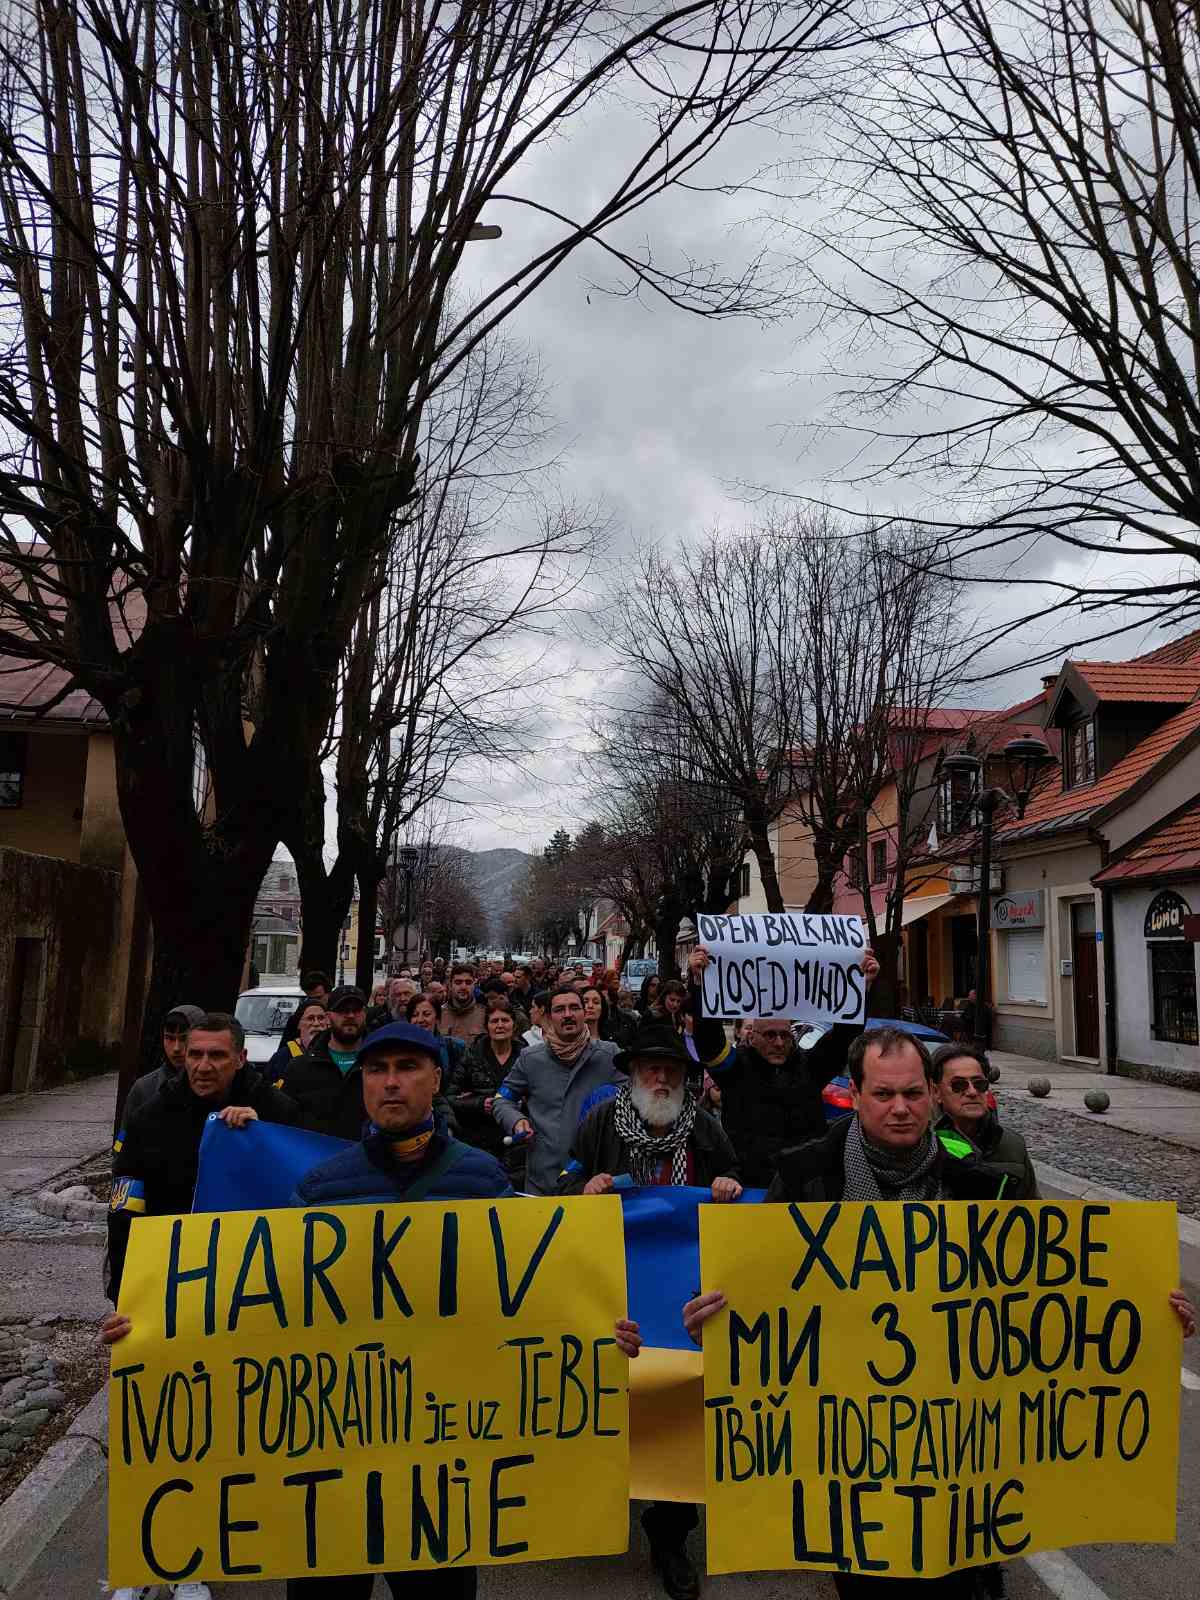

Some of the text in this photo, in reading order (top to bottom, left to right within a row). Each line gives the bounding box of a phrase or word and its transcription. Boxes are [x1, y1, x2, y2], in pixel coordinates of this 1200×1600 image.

[701, 914, 864, 949] OPEN BALKANS
[703, 955, 789, 1017] CLOSED
[165, 1206, 564, 1339] HARKIV
[788, 1203, 1111, 1293] ХАРЬКОВЕ
[728, 1304, 822, 1387] МИ
[931, 1291, 1142, 1385] ТОБОЮ
[232, 1342, 413, 1458] POBRATIM
[467, 1399, 504, 1441] UZ
[497, 1333, 622, 1440] TEBE
[818, 1393, 1001, 1481] ПОБРАТИМ
